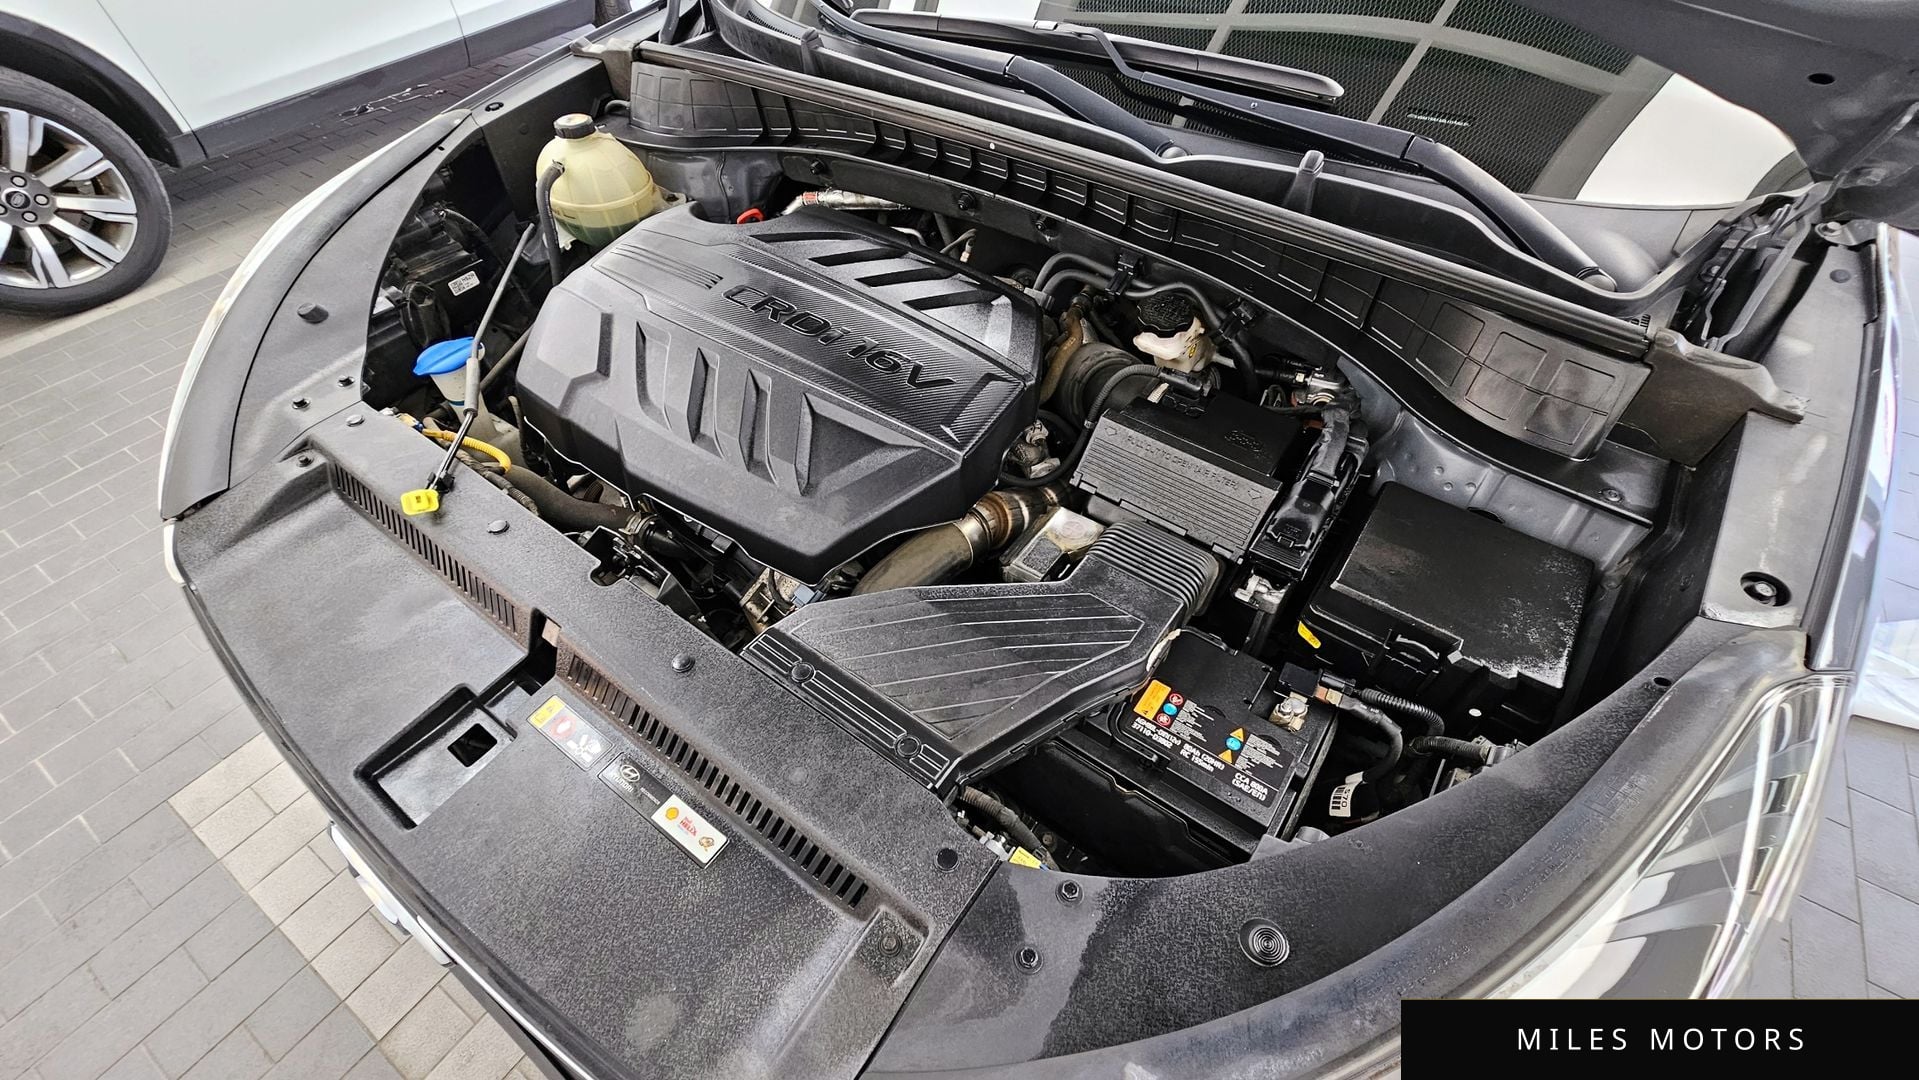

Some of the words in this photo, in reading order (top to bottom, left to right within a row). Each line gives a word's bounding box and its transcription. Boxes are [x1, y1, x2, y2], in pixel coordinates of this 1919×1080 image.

[722, 285, 851, 346] CRDi
[847, 336, 957, 389] 16V
[1180, 749, 1192, 761] RC
[1234, 772, 1251, 785] CCA
